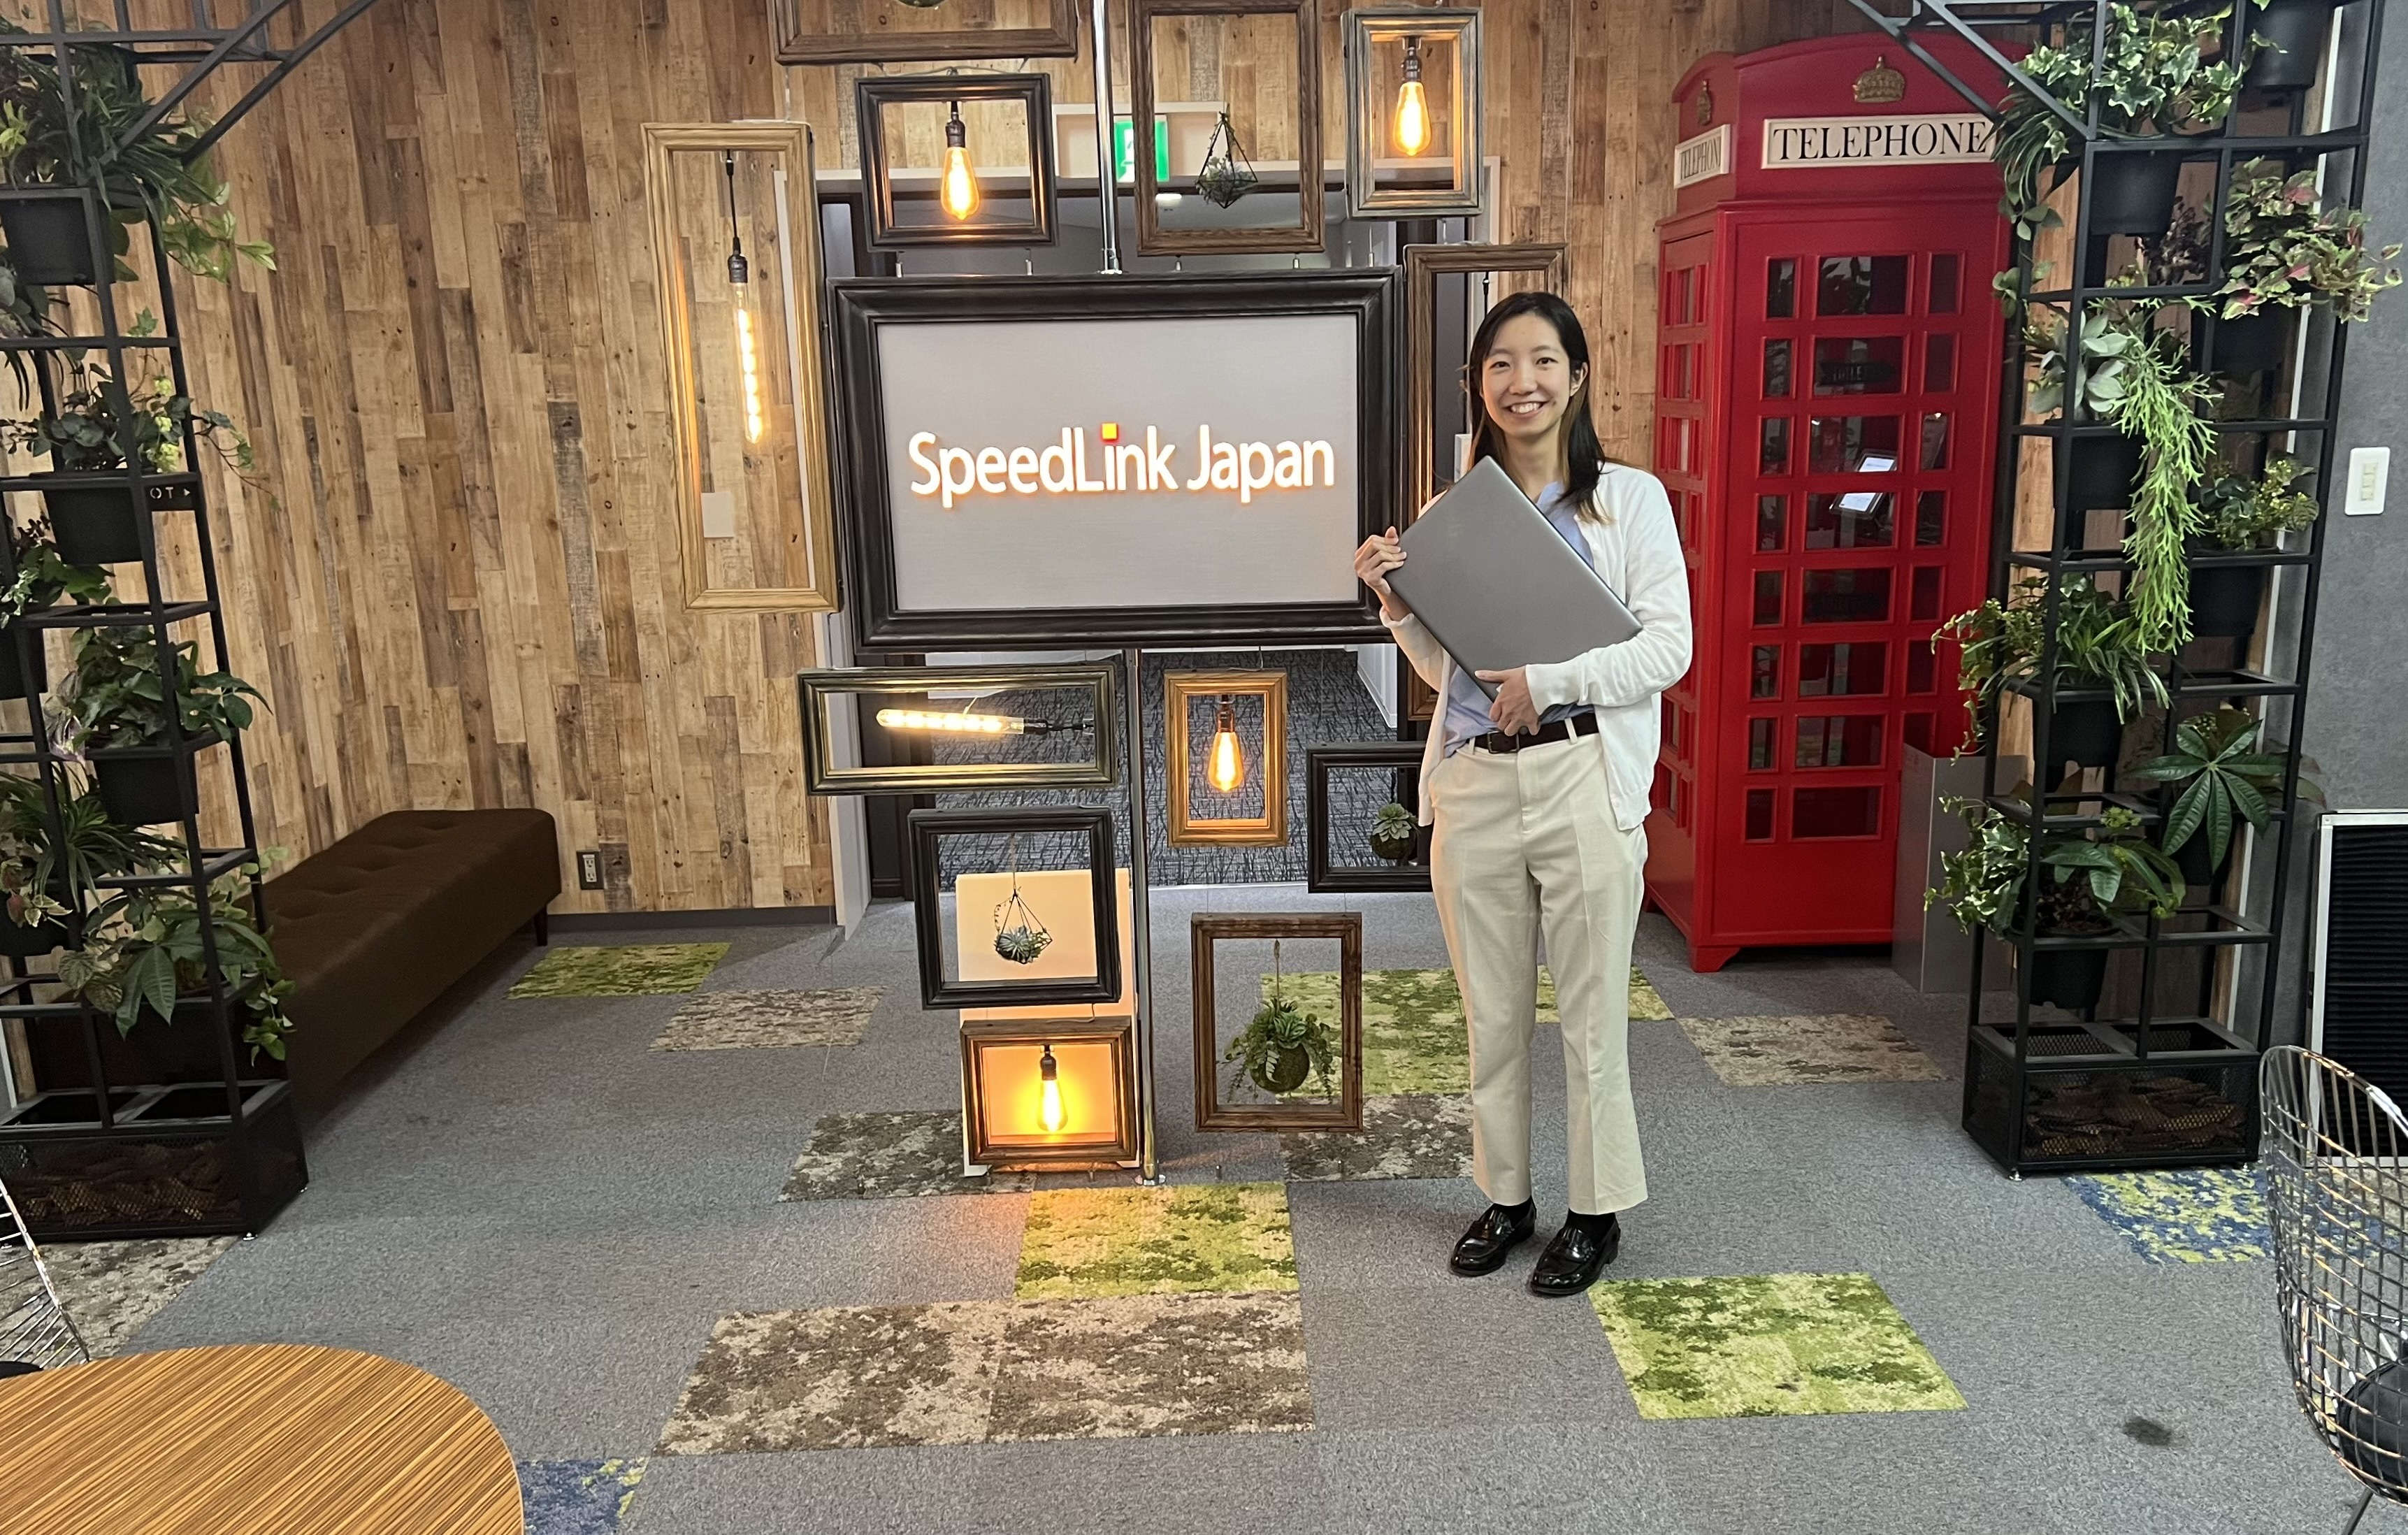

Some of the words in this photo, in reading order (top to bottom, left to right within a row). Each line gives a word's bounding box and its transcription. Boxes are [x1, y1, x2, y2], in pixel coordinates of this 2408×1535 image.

[1680, 136, 1722, 180] TELEPHON
[1773, 121, 1986, 160] TELEPHONE
[909, 422, 1179, 509] SpeedLink
[1187, 424, 1334, 503] Japan
